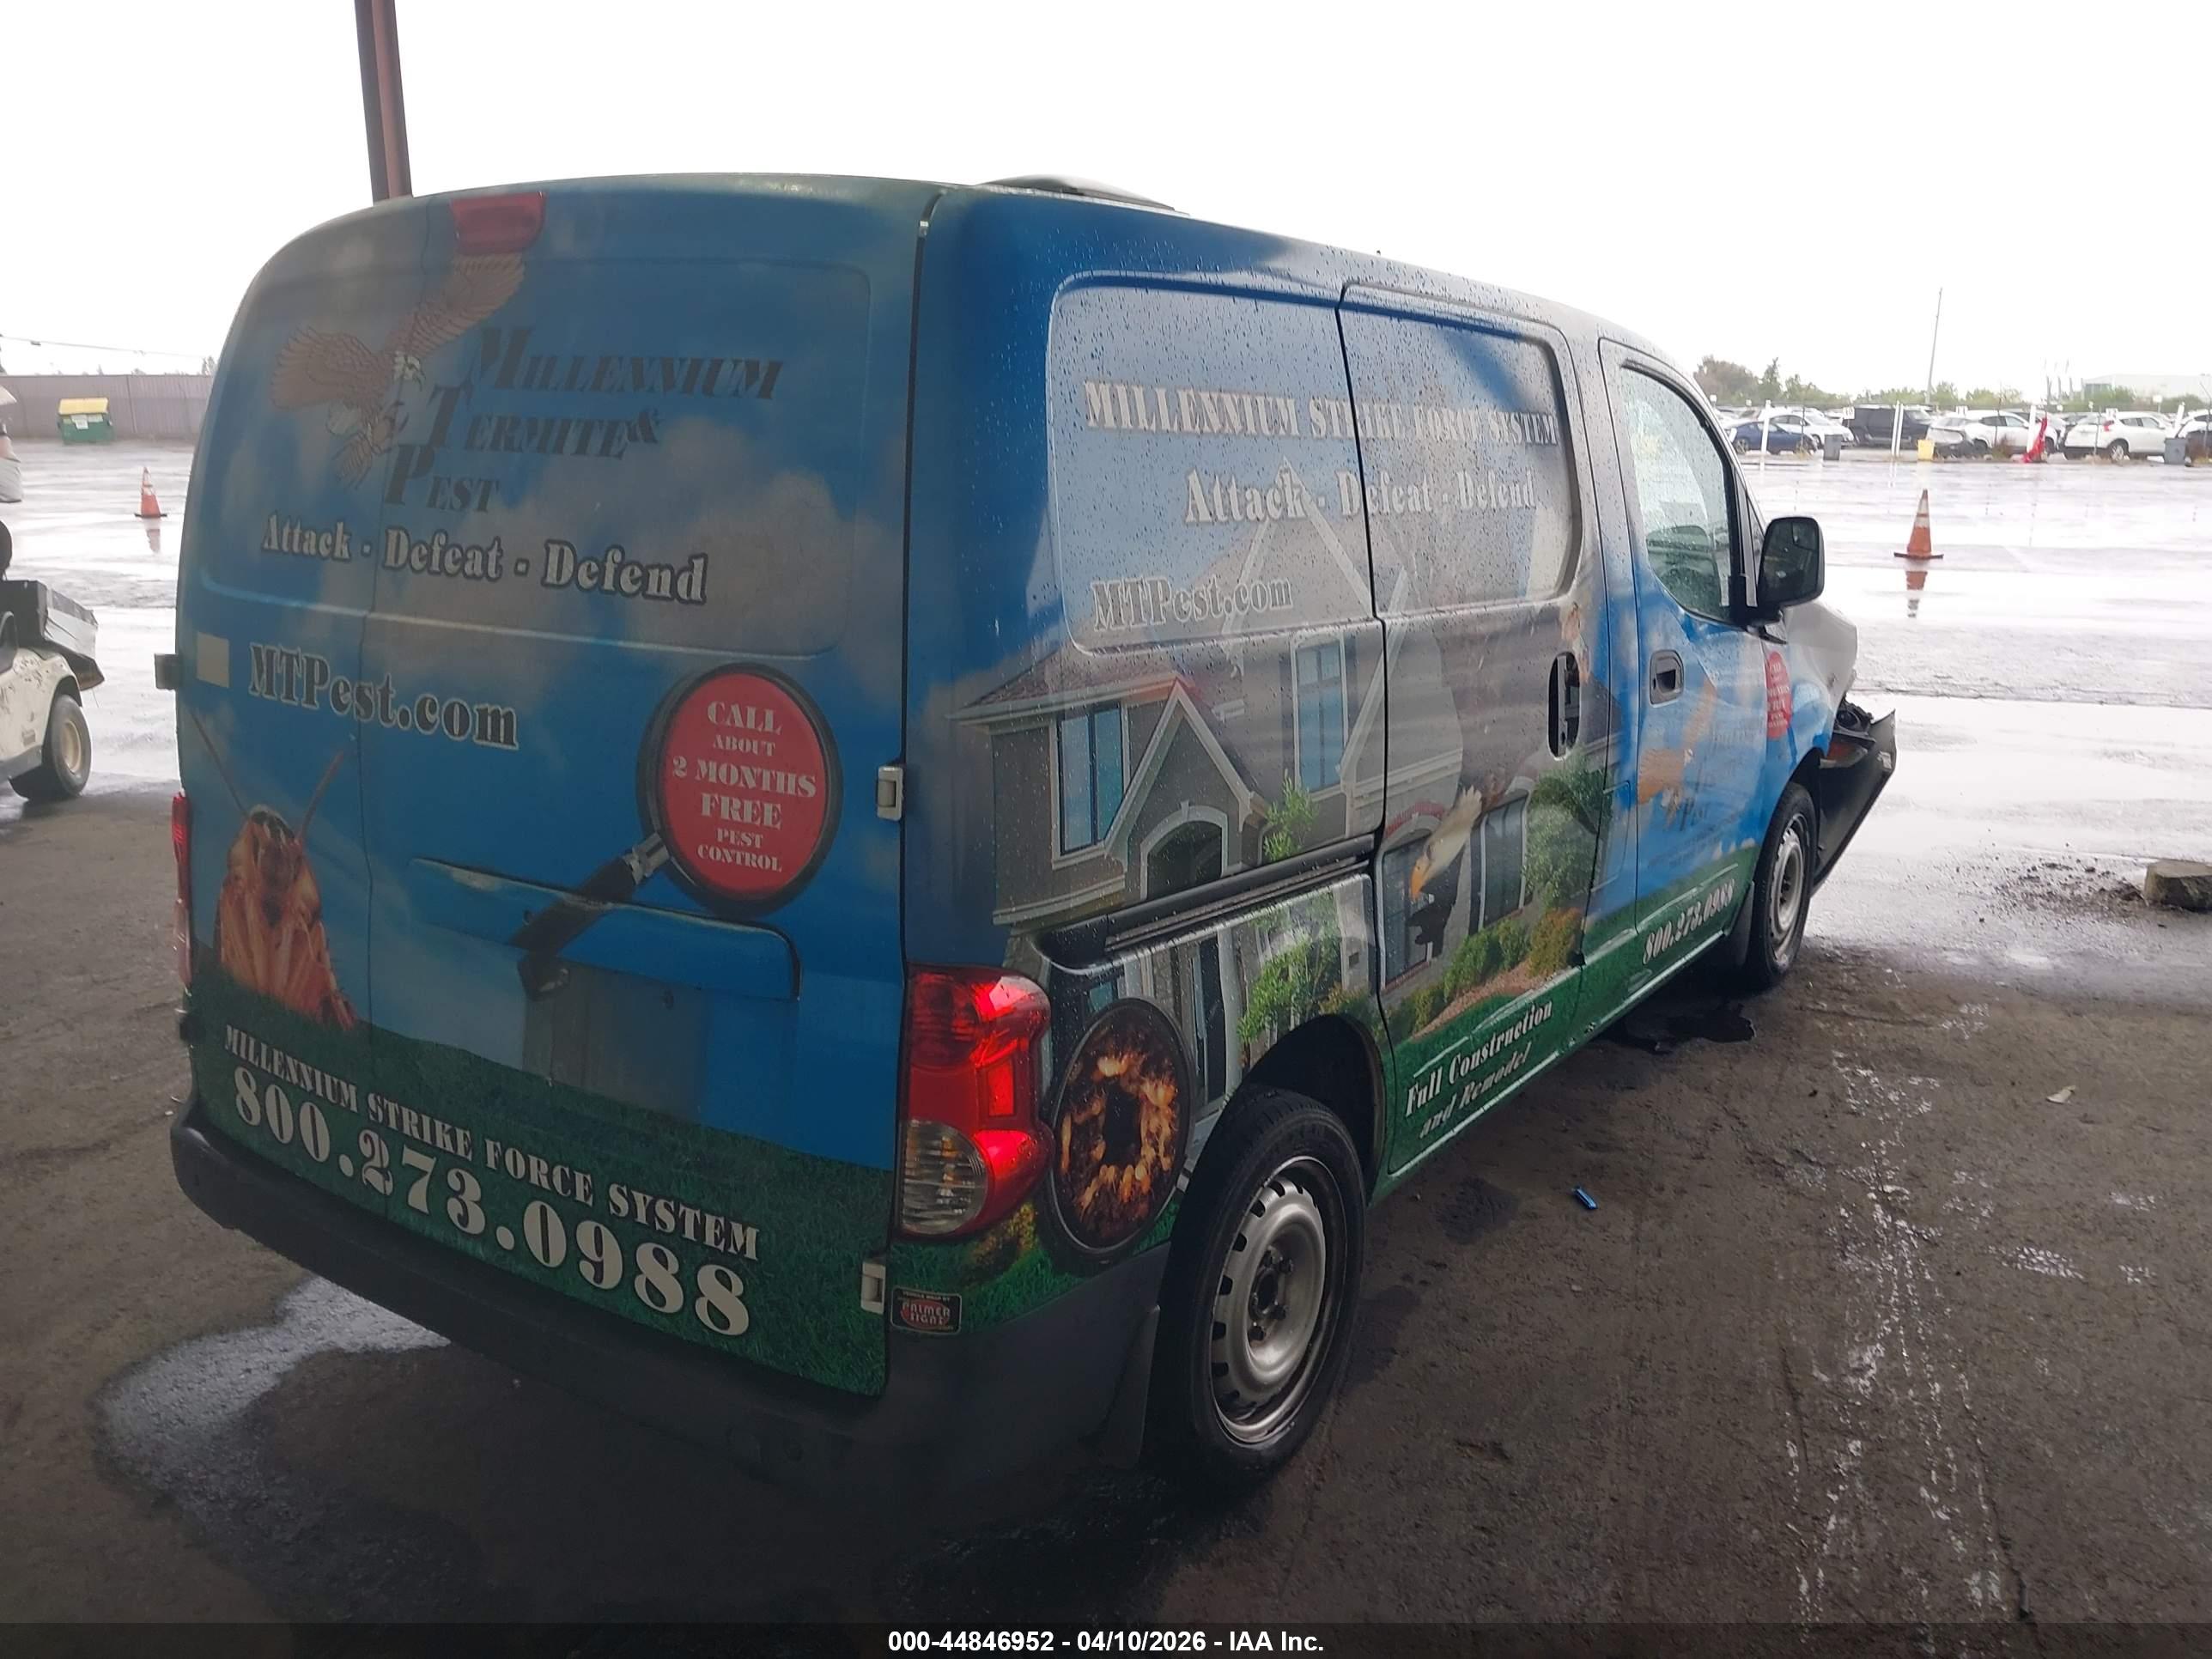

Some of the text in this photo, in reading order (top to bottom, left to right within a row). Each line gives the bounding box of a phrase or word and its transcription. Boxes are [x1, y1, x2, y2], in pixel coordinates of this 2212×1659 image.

[464, 326, 783, 400] MILLENNIUM
[1085, 381, 1300, 436] MILLENNIUM
[1488, 409, 1559, 447] SYSTEM
[383, 443, 500, 513] PEST
[1184, 469, 1310, 524] Attack
[1336, 470, 1433, 517] Defeat
[1456, 466, 1540, 511] Defend
[261, 511, 353, 562] Attack
[383, 526, 505, 580] Defeat
[541, 539, 709, 605] Defend
[1090, 574, 1295, 634] MTPest.com
[248, 641, 520, 751] MTPest.com
[707, 701, 782, 736] CALL
[672, 755, 817, 799] 2 MONTHS
[713, 734, 776, 757] ABOUT
[700, 792, 783, 831] FREE
[716, 827, 764, 849] PEST
[696, 843, 783, 873] CONTROL
[1406, 1000, 1553, 1118] Full Construction
[1419, 1040, 1533, 1140] and Remodel
[224, 1024, 761, 1261] MILLENNIUM STRIKE FORCE SYSTEM
[234, 1066, 750, 1337] 800.273.0988
